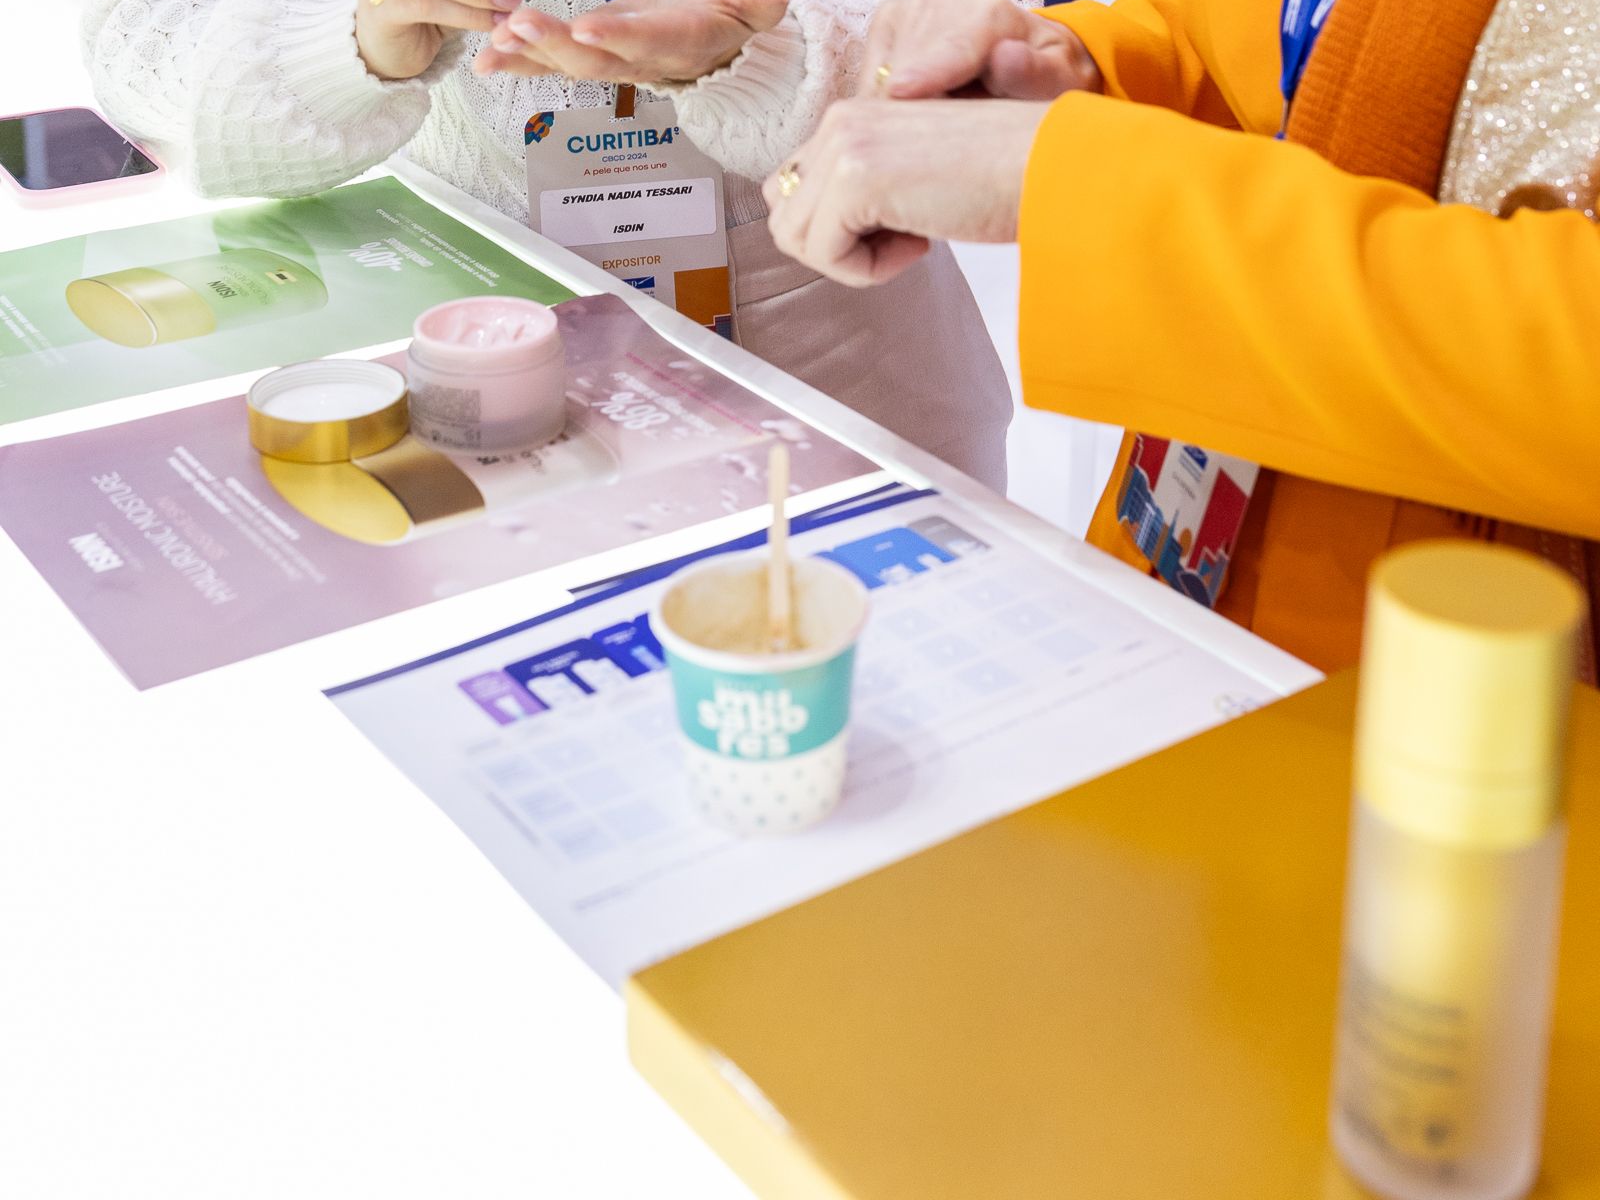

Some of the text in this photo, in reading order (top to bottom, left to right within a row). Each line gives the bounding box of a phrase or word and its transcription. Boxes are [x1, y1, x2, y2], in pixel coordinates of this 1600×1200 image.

[602, 152, 648, 163] CBCD 2024
[593, 167, 612, 176] pele
[614, 165, 631, 174] que
[633, 163, 649, 171] nos
[562, 186, 693, 205] SYNDIA NADIA TESSARI
[613, 223, 645, 234] ISDIN
[602, 255, 661, 270] EXPOSITOR
